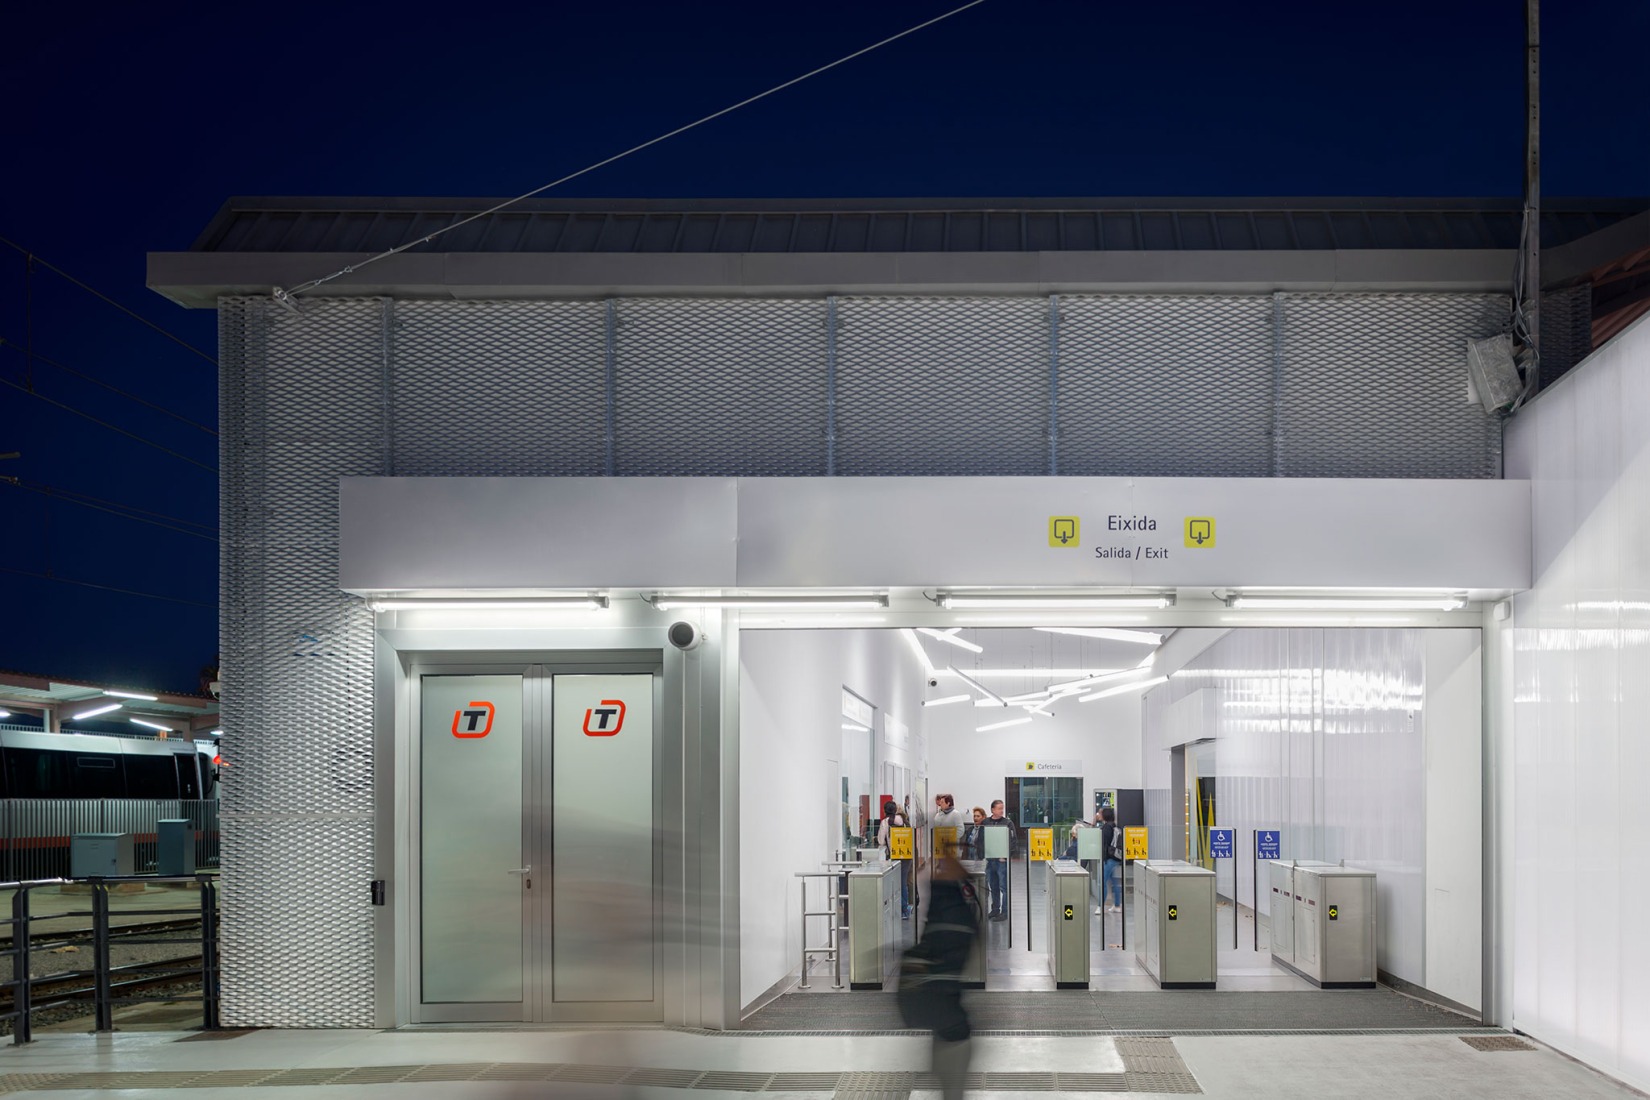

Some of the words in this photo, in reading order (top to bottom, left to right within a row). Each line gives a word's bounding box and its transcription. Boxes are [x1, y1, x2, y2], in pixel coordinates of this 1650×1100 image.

[1107, 515, 1157, 531] Eixida
[1095, 546, 1131, 559] Salida
[1145, 547, 1169, 559] Exit
